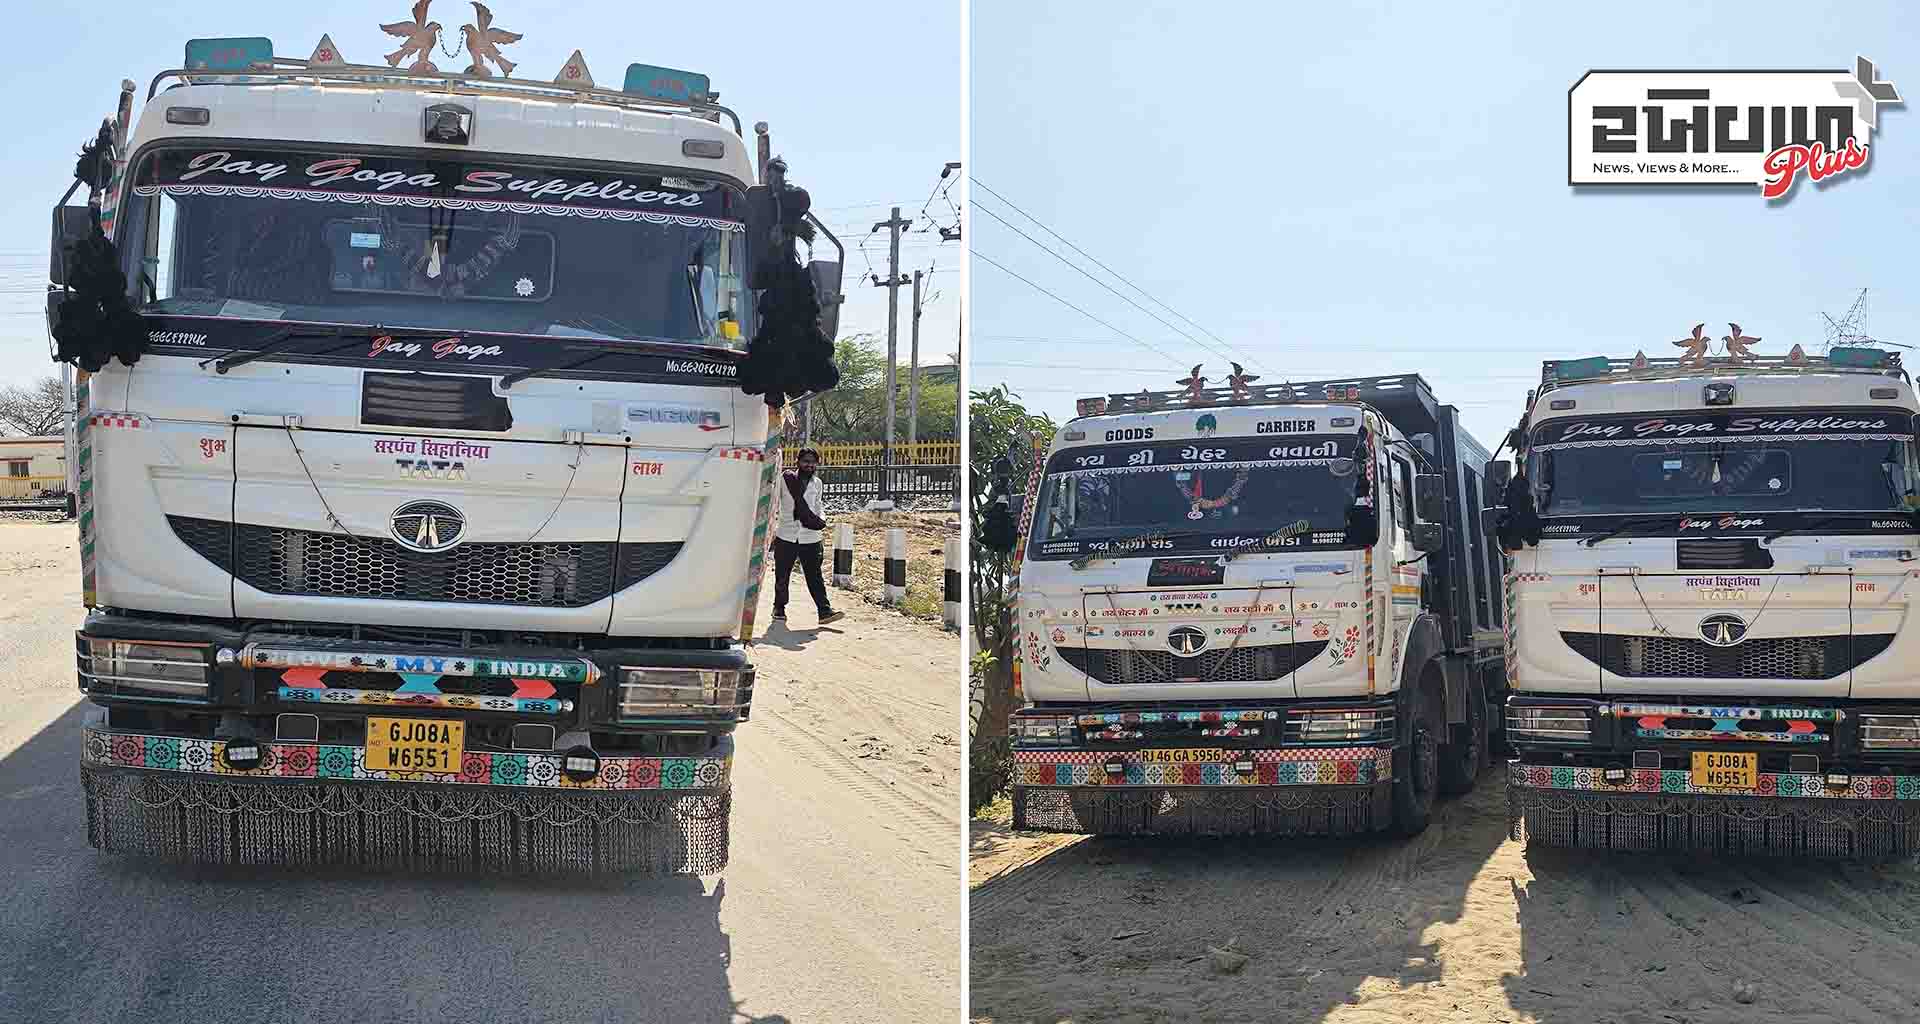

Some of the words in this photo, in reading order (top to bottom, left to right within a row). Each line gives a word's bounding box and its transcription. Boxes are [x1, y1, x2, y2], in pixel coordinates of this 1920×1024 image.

[180, 152, 287, 181] Jay
[306, 158, 440, 190] Goga
[454, 172, 704, 207] Suppliers
[368, 336, 422, 358] Jay
[432, 337, 503, 360] Goga
[1105, 427, 1154, 442] GOODS
[1256, 419, 1316, 433] CARRIER
[1560, 422, 1623, 441] Jay
[1633, 419, 1716, 438] Goga
[1725, 415, 1888, 432] Suppliers
[199, 438, 227, 458] शुभ
[374, 437, 416, 454] सरपंच
[1128, 449, 1154, 466] શ્રી
[1181, 445, 1227, 462] ચેહર
[1268, 440, 1338, 459] ભવાની
[396, 458, 470, 480] TATA
[633, 461, 664, 476] लाभ
[1680, 517, 1712, 531] Jay
[1718, 516, 1764, 530] Goga
[395, 655, 448, 673] MY
[489, 661, 567, 678] INDIA
[1772, 708, 1823, 719] INDIA
[389, 722, 450, 744] GJ08A
[389, 746, 449, 768] W6551
[1142, 750, 1154, 762] RJ
[1157, 750, 1171, 762] 46
[1173, 750, 1189, 762] GA
[1192, 749, 1220, 761] 5956
[1707, 754, 1748, 769] GJ08A
[1707, 771, 1748, 786] W6551
